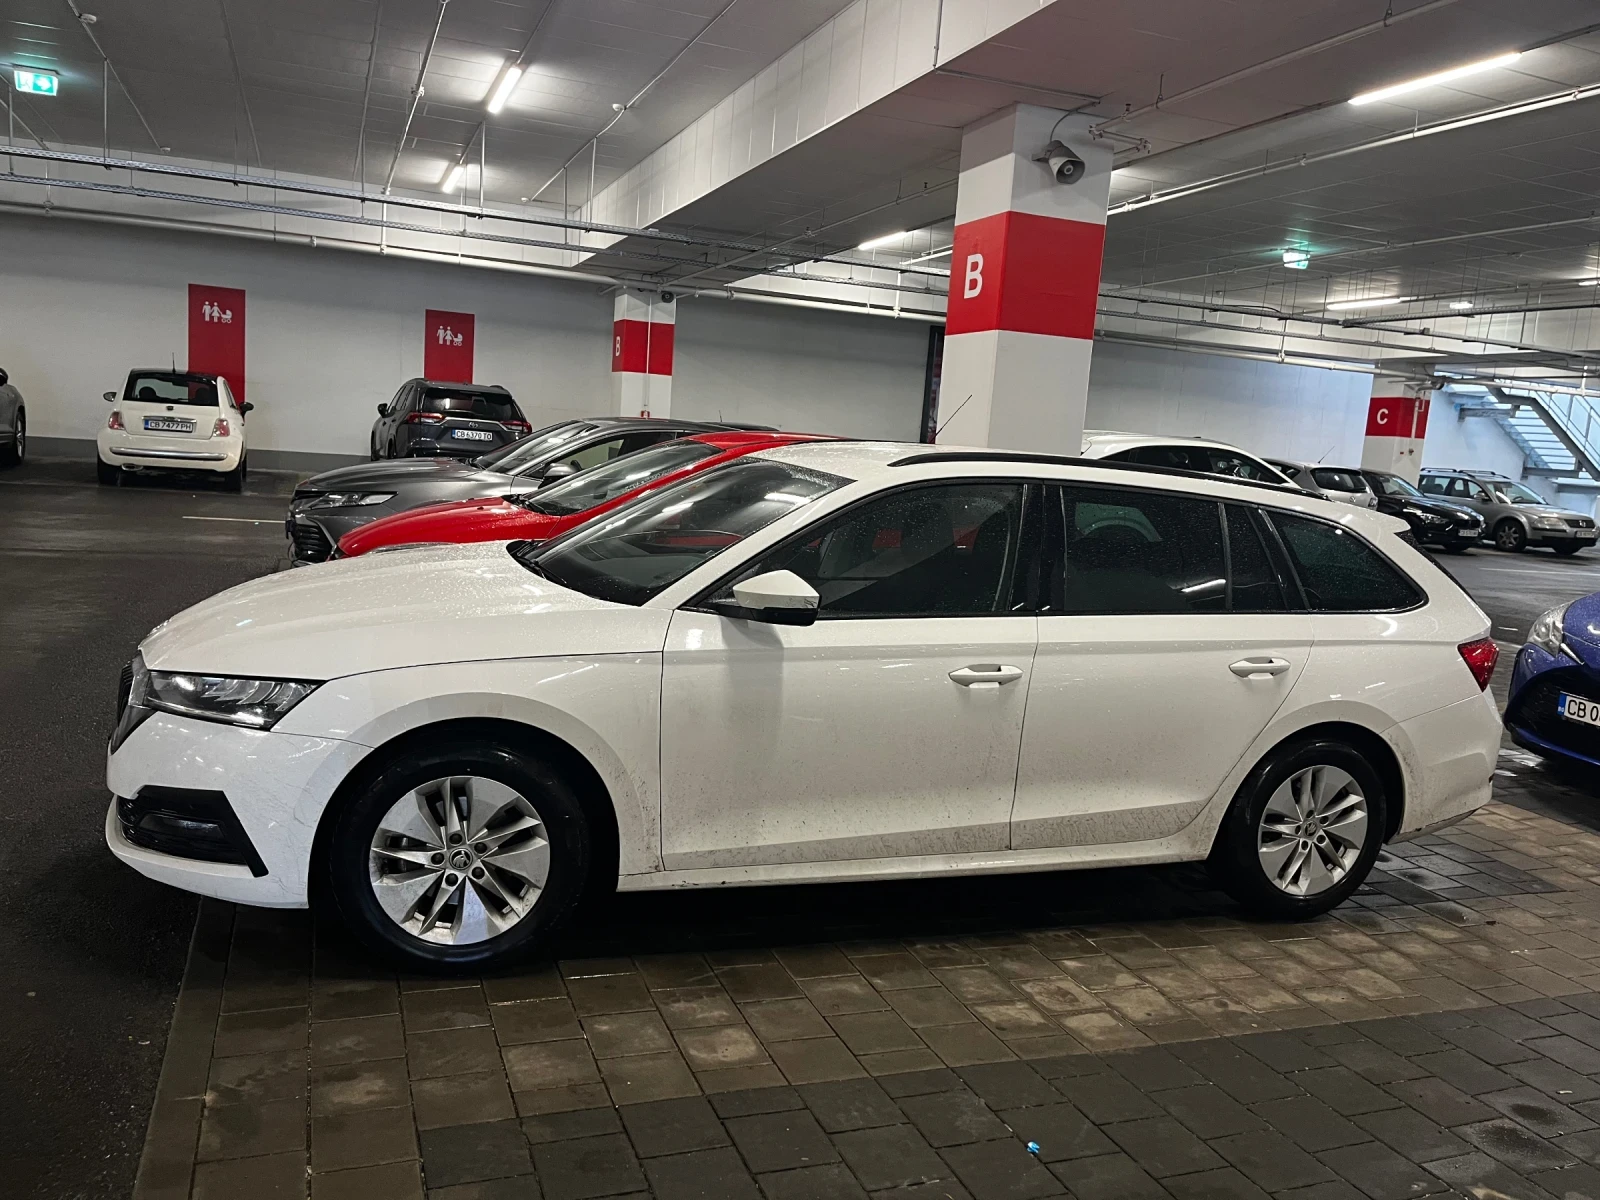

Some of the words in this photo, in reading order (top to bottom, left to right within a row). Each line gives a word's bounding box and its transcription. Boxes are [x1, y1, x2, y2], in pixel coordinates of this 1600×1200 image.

[963, 253, 984, 299] B
[615, 335, 621, 357] B
[161, 421, 180, 429] 7477
[1376, 408, 1389, 425] C
[456, 430, 466, 438] CB
[1567, 699, 1587, 719] CB
[1590, 705, 1600, 723] 0
